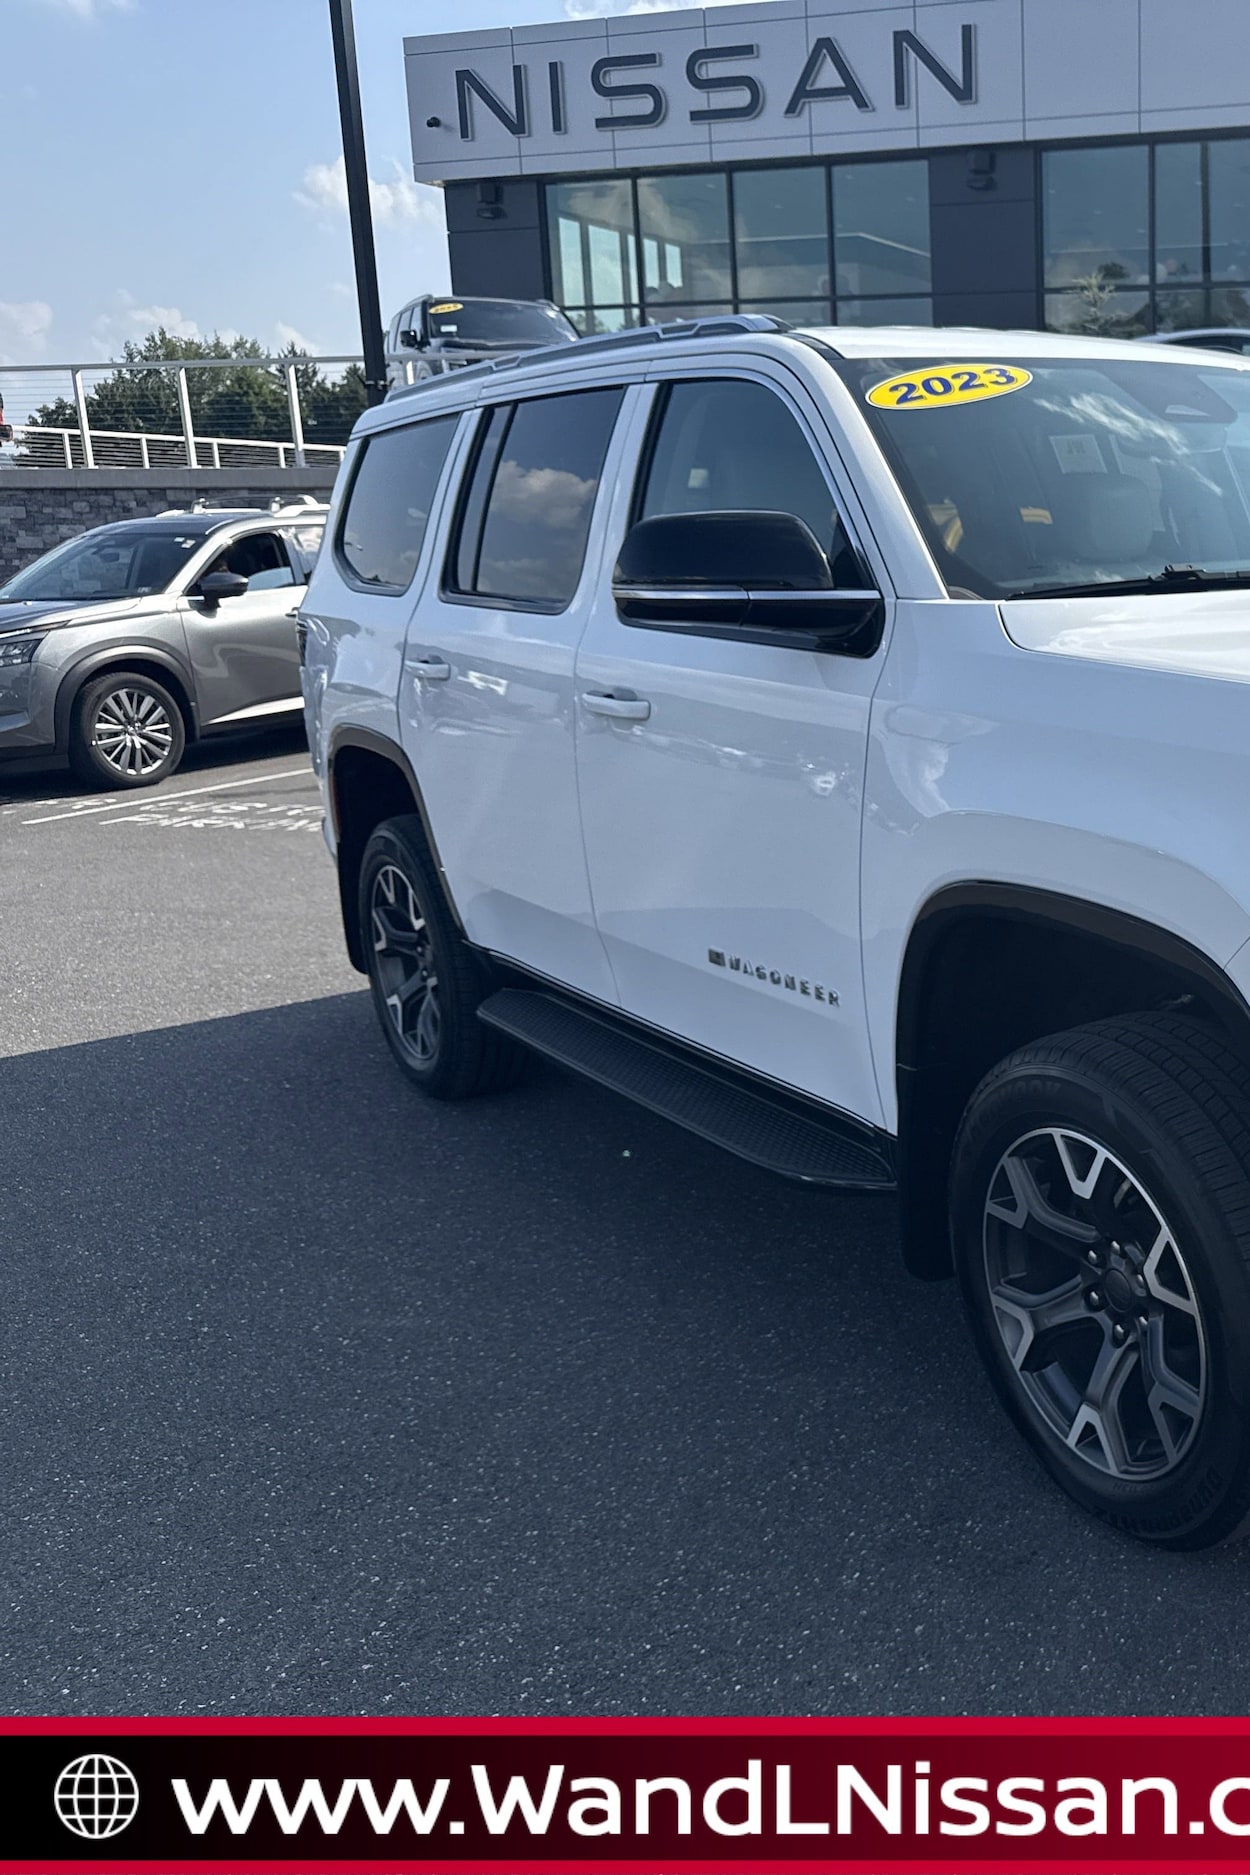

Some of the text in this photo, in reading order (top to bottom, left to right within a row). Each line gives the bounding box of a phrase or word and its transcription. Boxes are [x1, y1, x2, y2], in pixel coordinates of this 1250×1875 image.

[455, 23, 977, 142] NISSAN
[889, 368, 1019, 406] 2023
[729, 953, 841, 1007] WAGONEER
